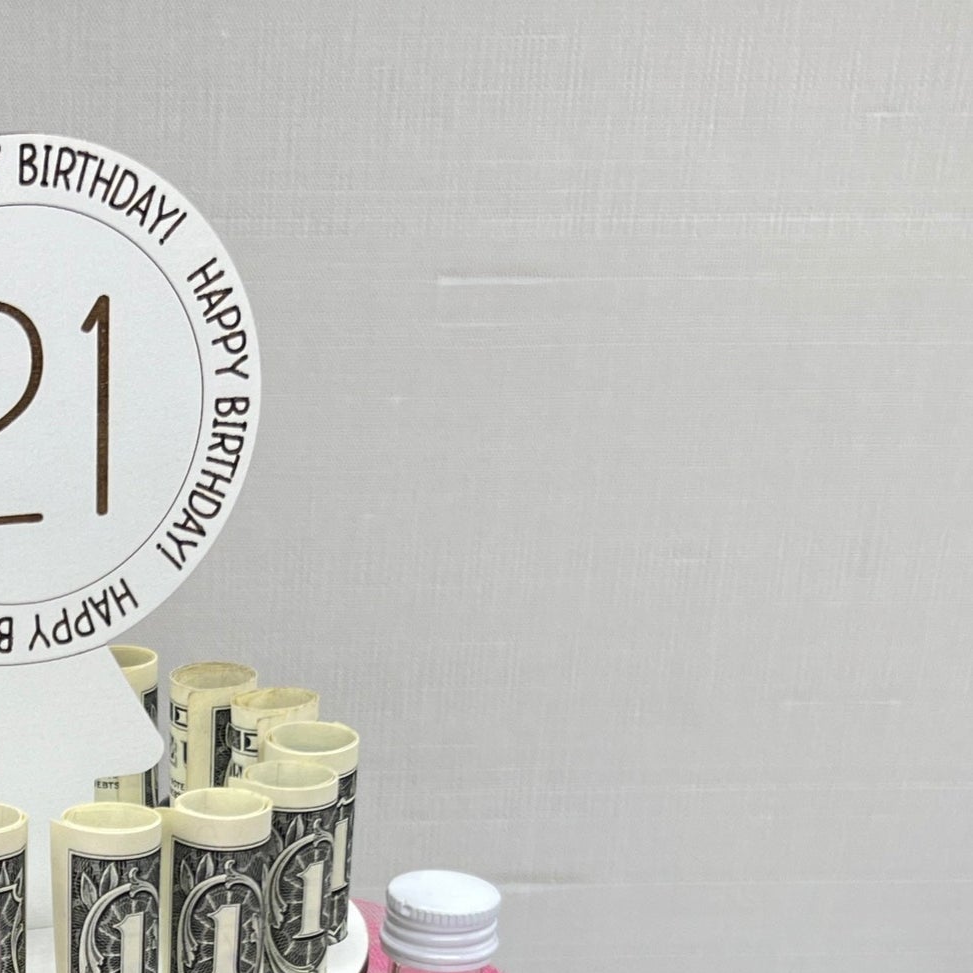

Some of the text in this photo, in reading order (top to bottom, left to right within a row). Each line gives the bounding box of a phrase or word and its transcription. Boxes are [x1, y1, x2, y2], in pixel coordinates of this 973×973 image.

[18, 143, 187, 245] BIRTHDAY!
[156, 257, 250, 570] HAPPY BIRTHDAY!
[28, 578, 139, 651] HAPPY
[292, 860, 325, 940] 1
